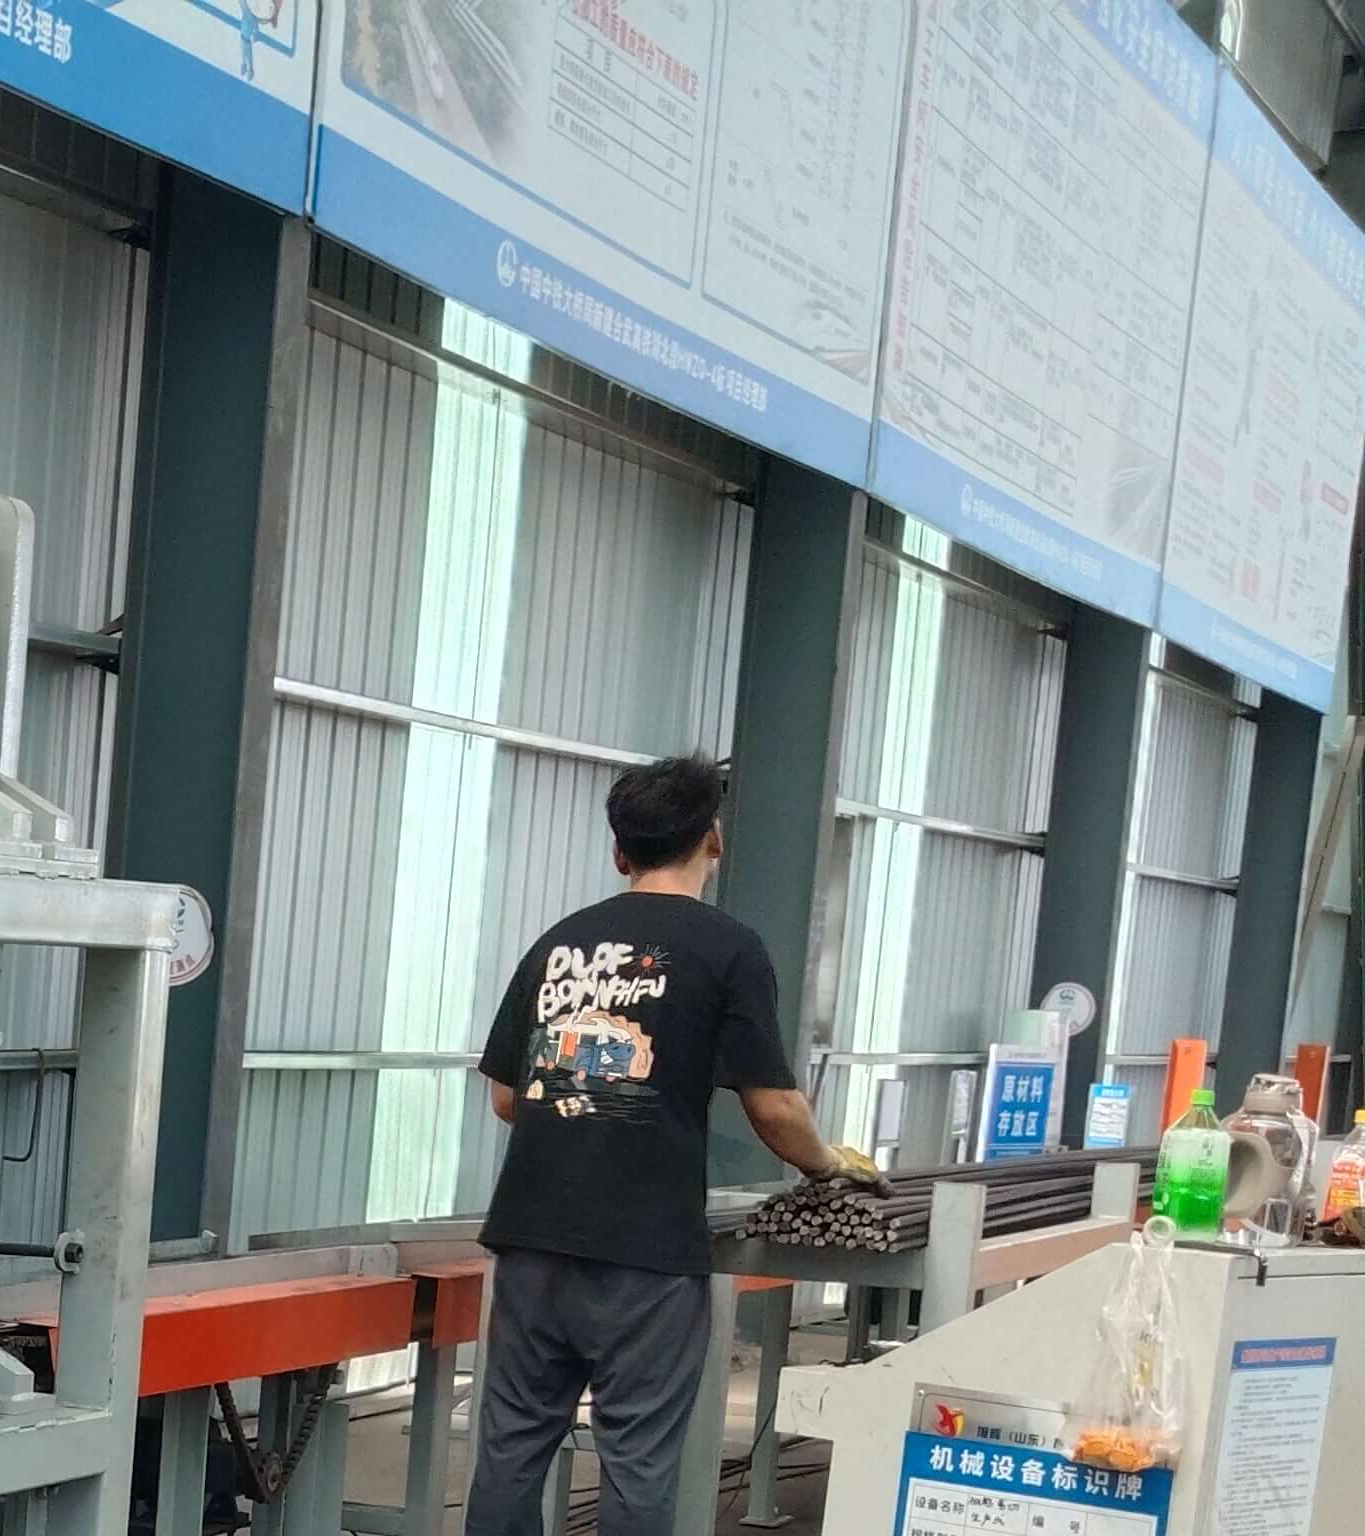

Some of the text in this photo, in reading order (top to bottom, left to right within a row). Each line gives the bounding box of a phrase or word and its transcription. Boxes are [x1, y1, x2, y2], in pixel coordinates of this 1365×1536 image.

[1000, 1074, 1044, 1103] 原材料
[997, 1109, 1039, 1137] 存放区
[930, 1445, 1143, 1500] 机械设备标识牌
[915, 1496, 965, 1515] 设备名称
